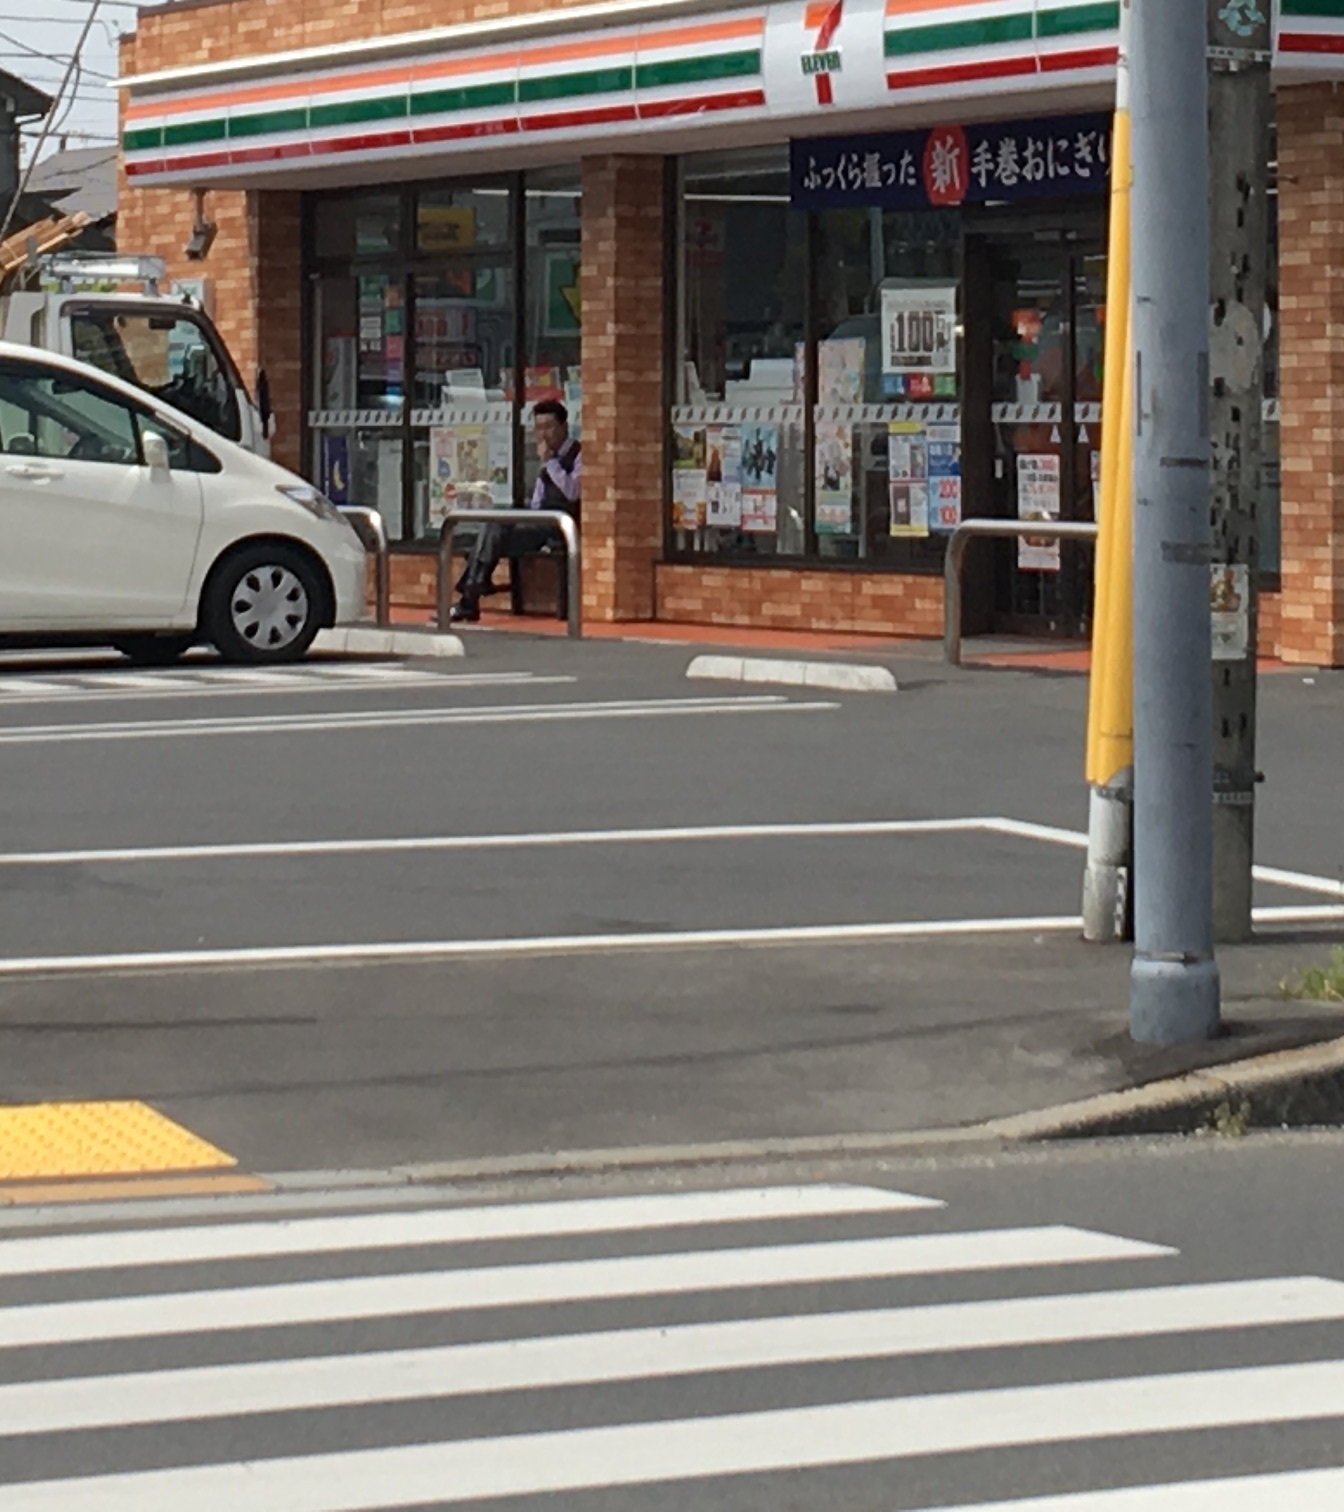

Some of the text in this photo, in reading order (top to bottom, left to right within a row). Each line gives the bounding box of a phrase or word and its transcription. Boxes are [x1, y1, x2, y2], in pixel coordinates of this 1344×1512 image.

[804, 149, 917, 191] ふっくら握った
[930, 136, 961, 193] 新
